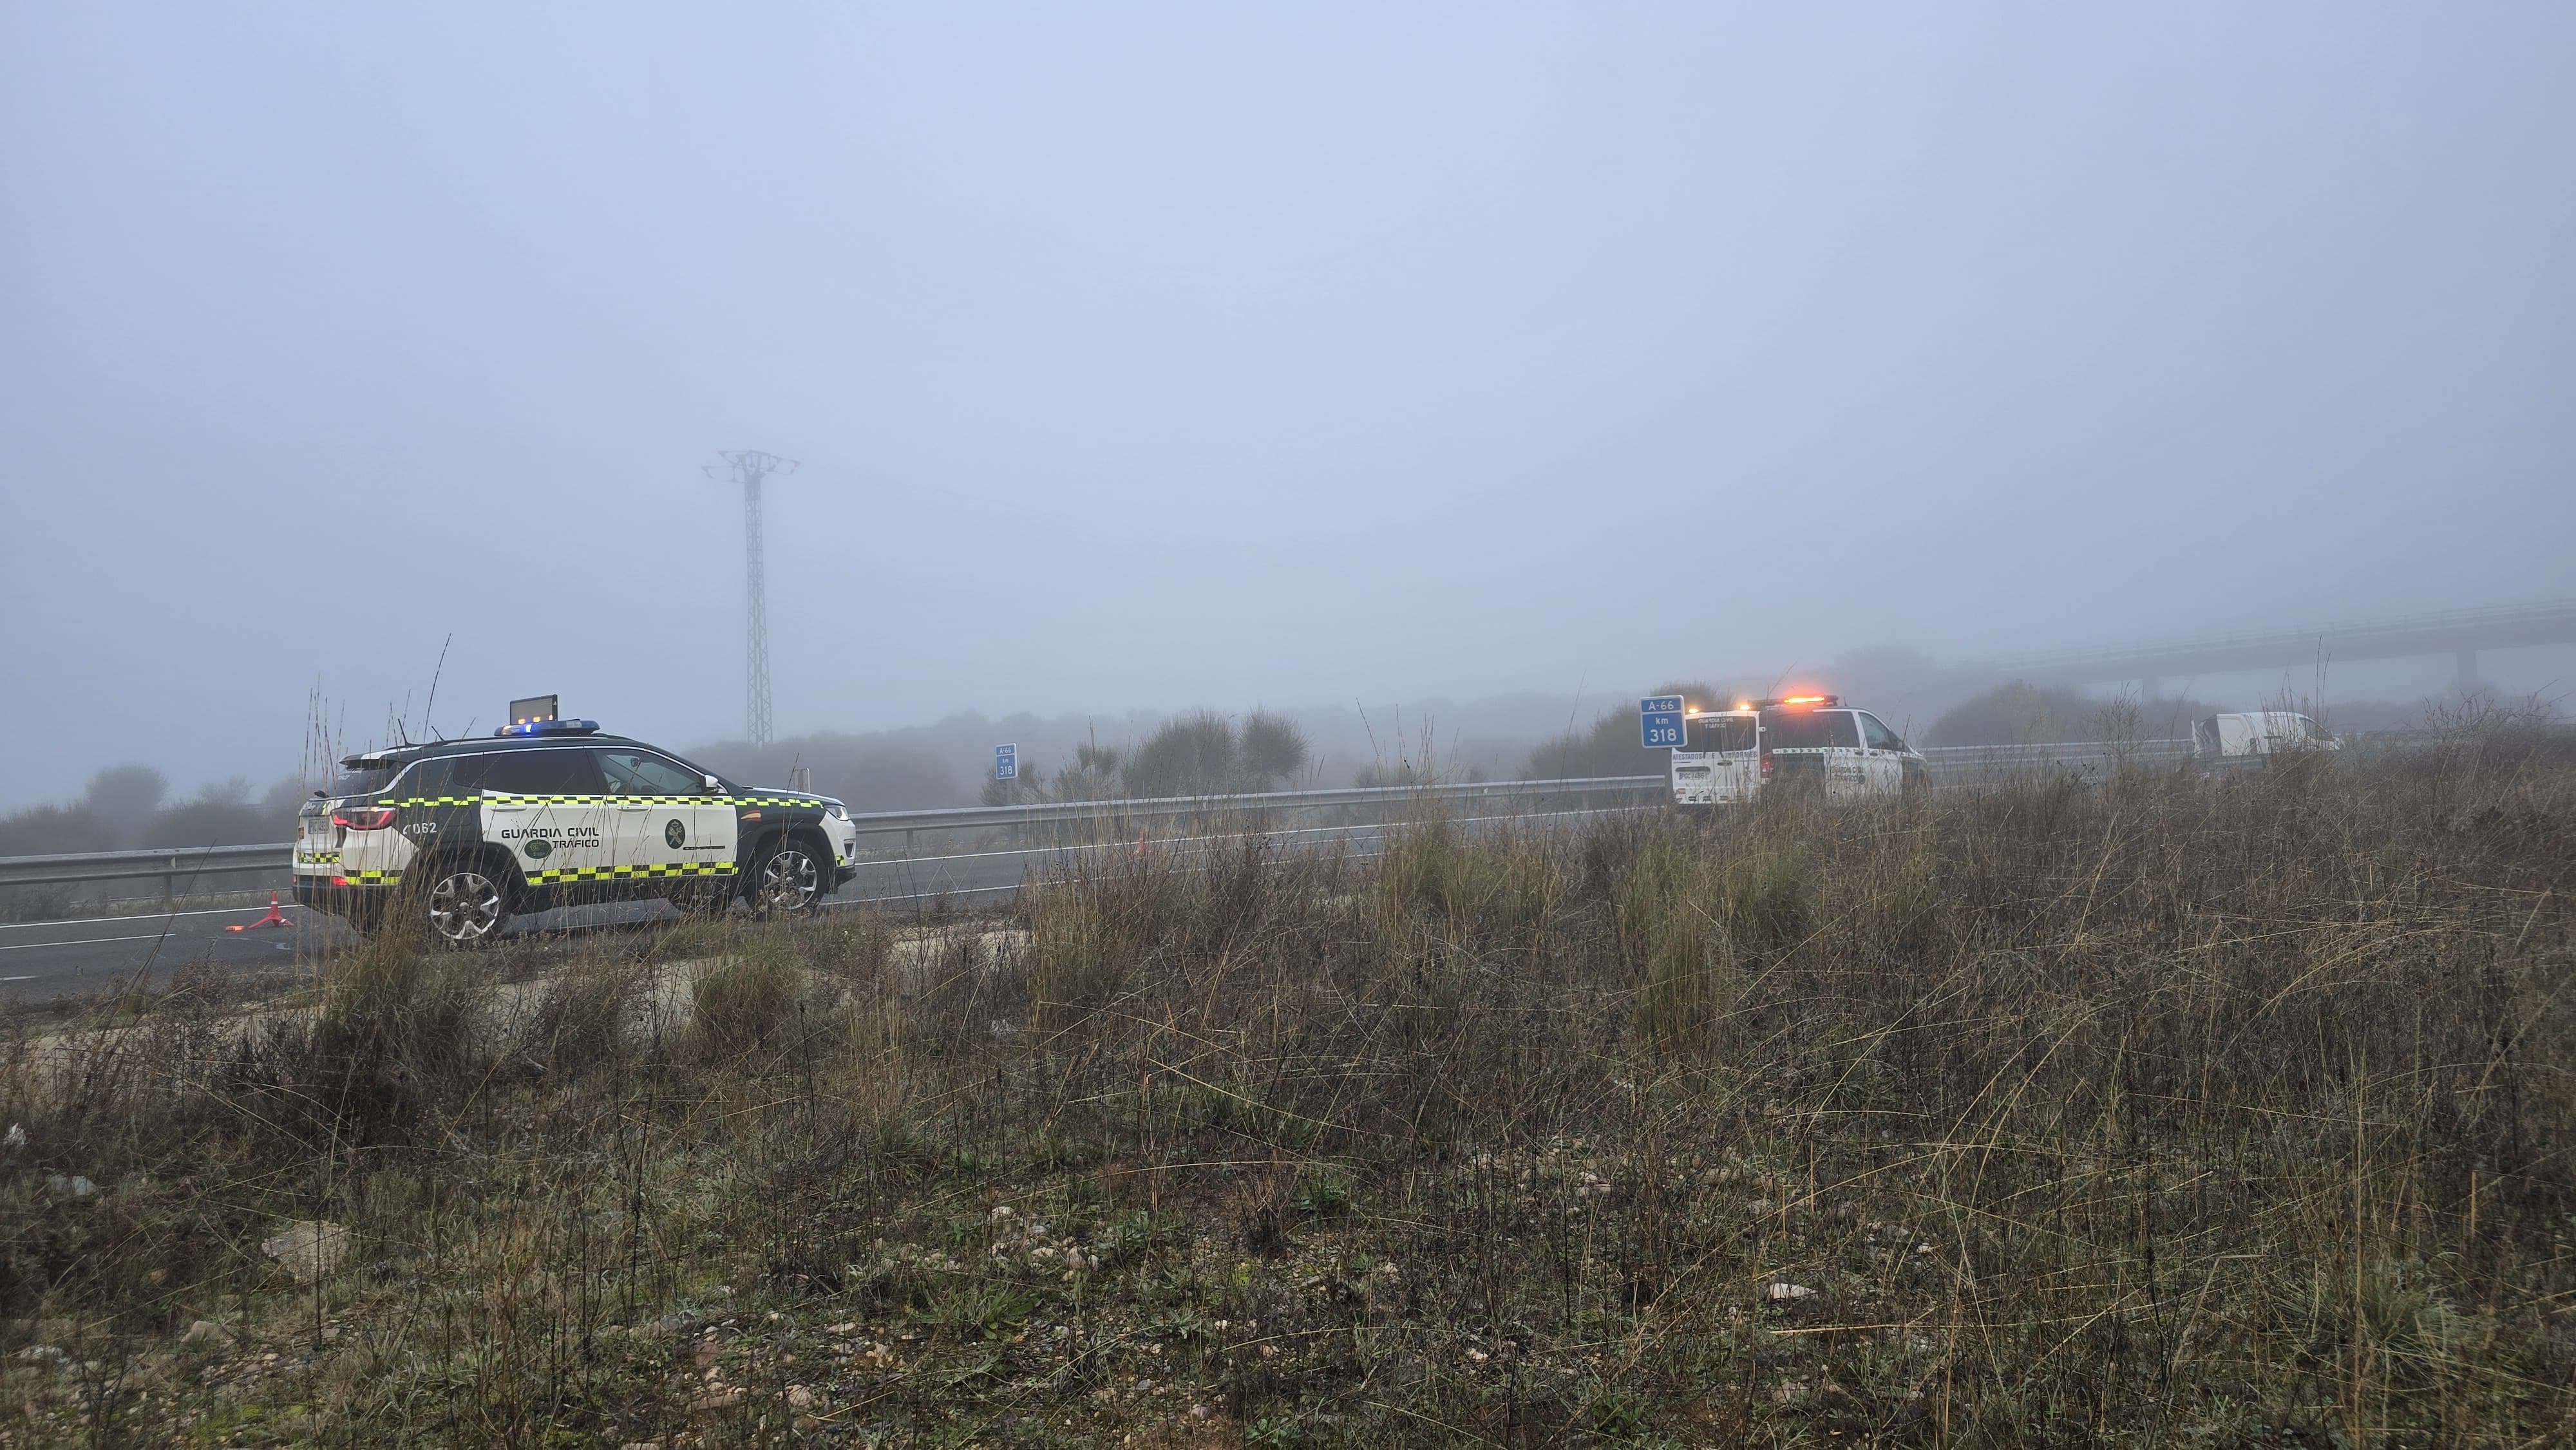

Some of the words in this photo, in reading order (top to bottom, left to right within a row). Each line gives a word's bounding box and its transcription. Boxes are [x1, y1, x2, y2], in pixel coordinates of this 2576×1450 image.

[1649, 701, 1674, 711] A-66
[1650, 728, 1677, 742] 318
[999, 765, 1012, 775] 318
[413, 822, 437, 834] 062
[502, 828, 562, 838] GUARDIA
[567, 827, 599, 837] CIVIL
[552, 838, 600, 849] TRÁFICO
